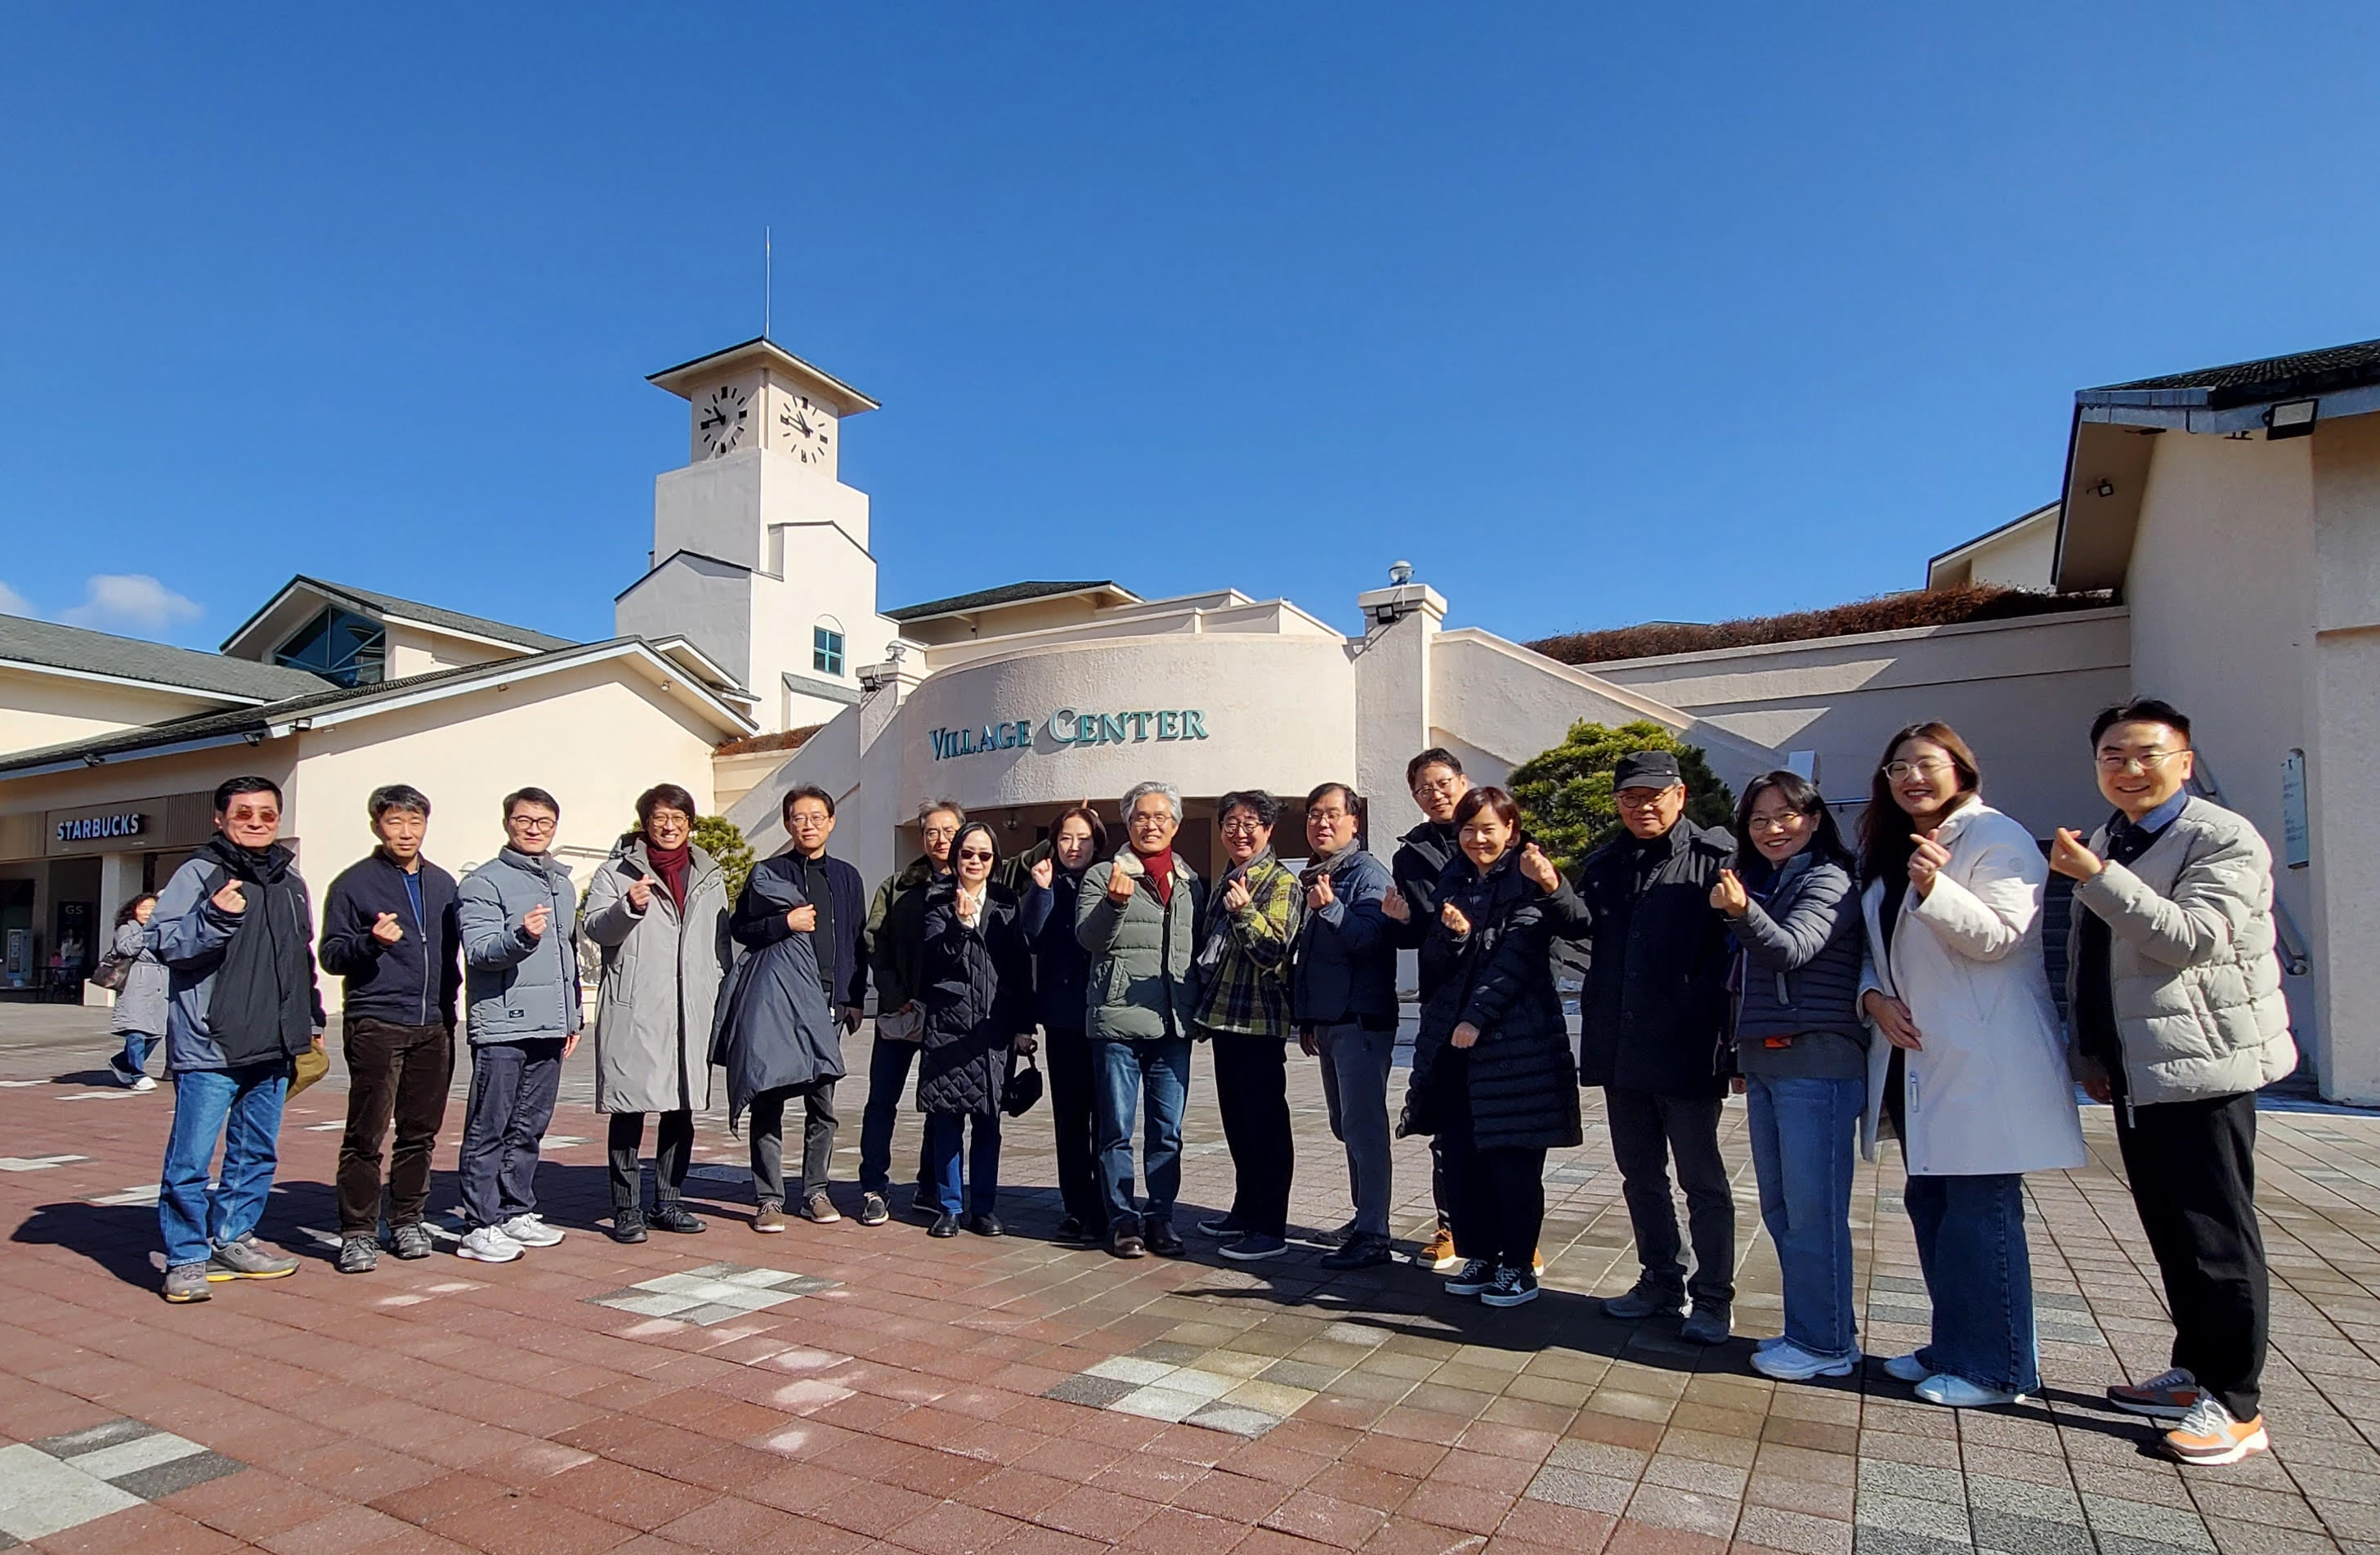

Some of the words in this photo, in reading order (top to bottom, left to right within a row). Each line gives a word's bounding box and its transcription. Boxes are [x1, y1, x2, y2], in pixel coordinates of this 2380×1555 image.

[928, 719, 1034, 761] VILLAGE
[1048, 706, 1209, 743] CENTER
[57, 813, 139, 841] STARBUCKS
